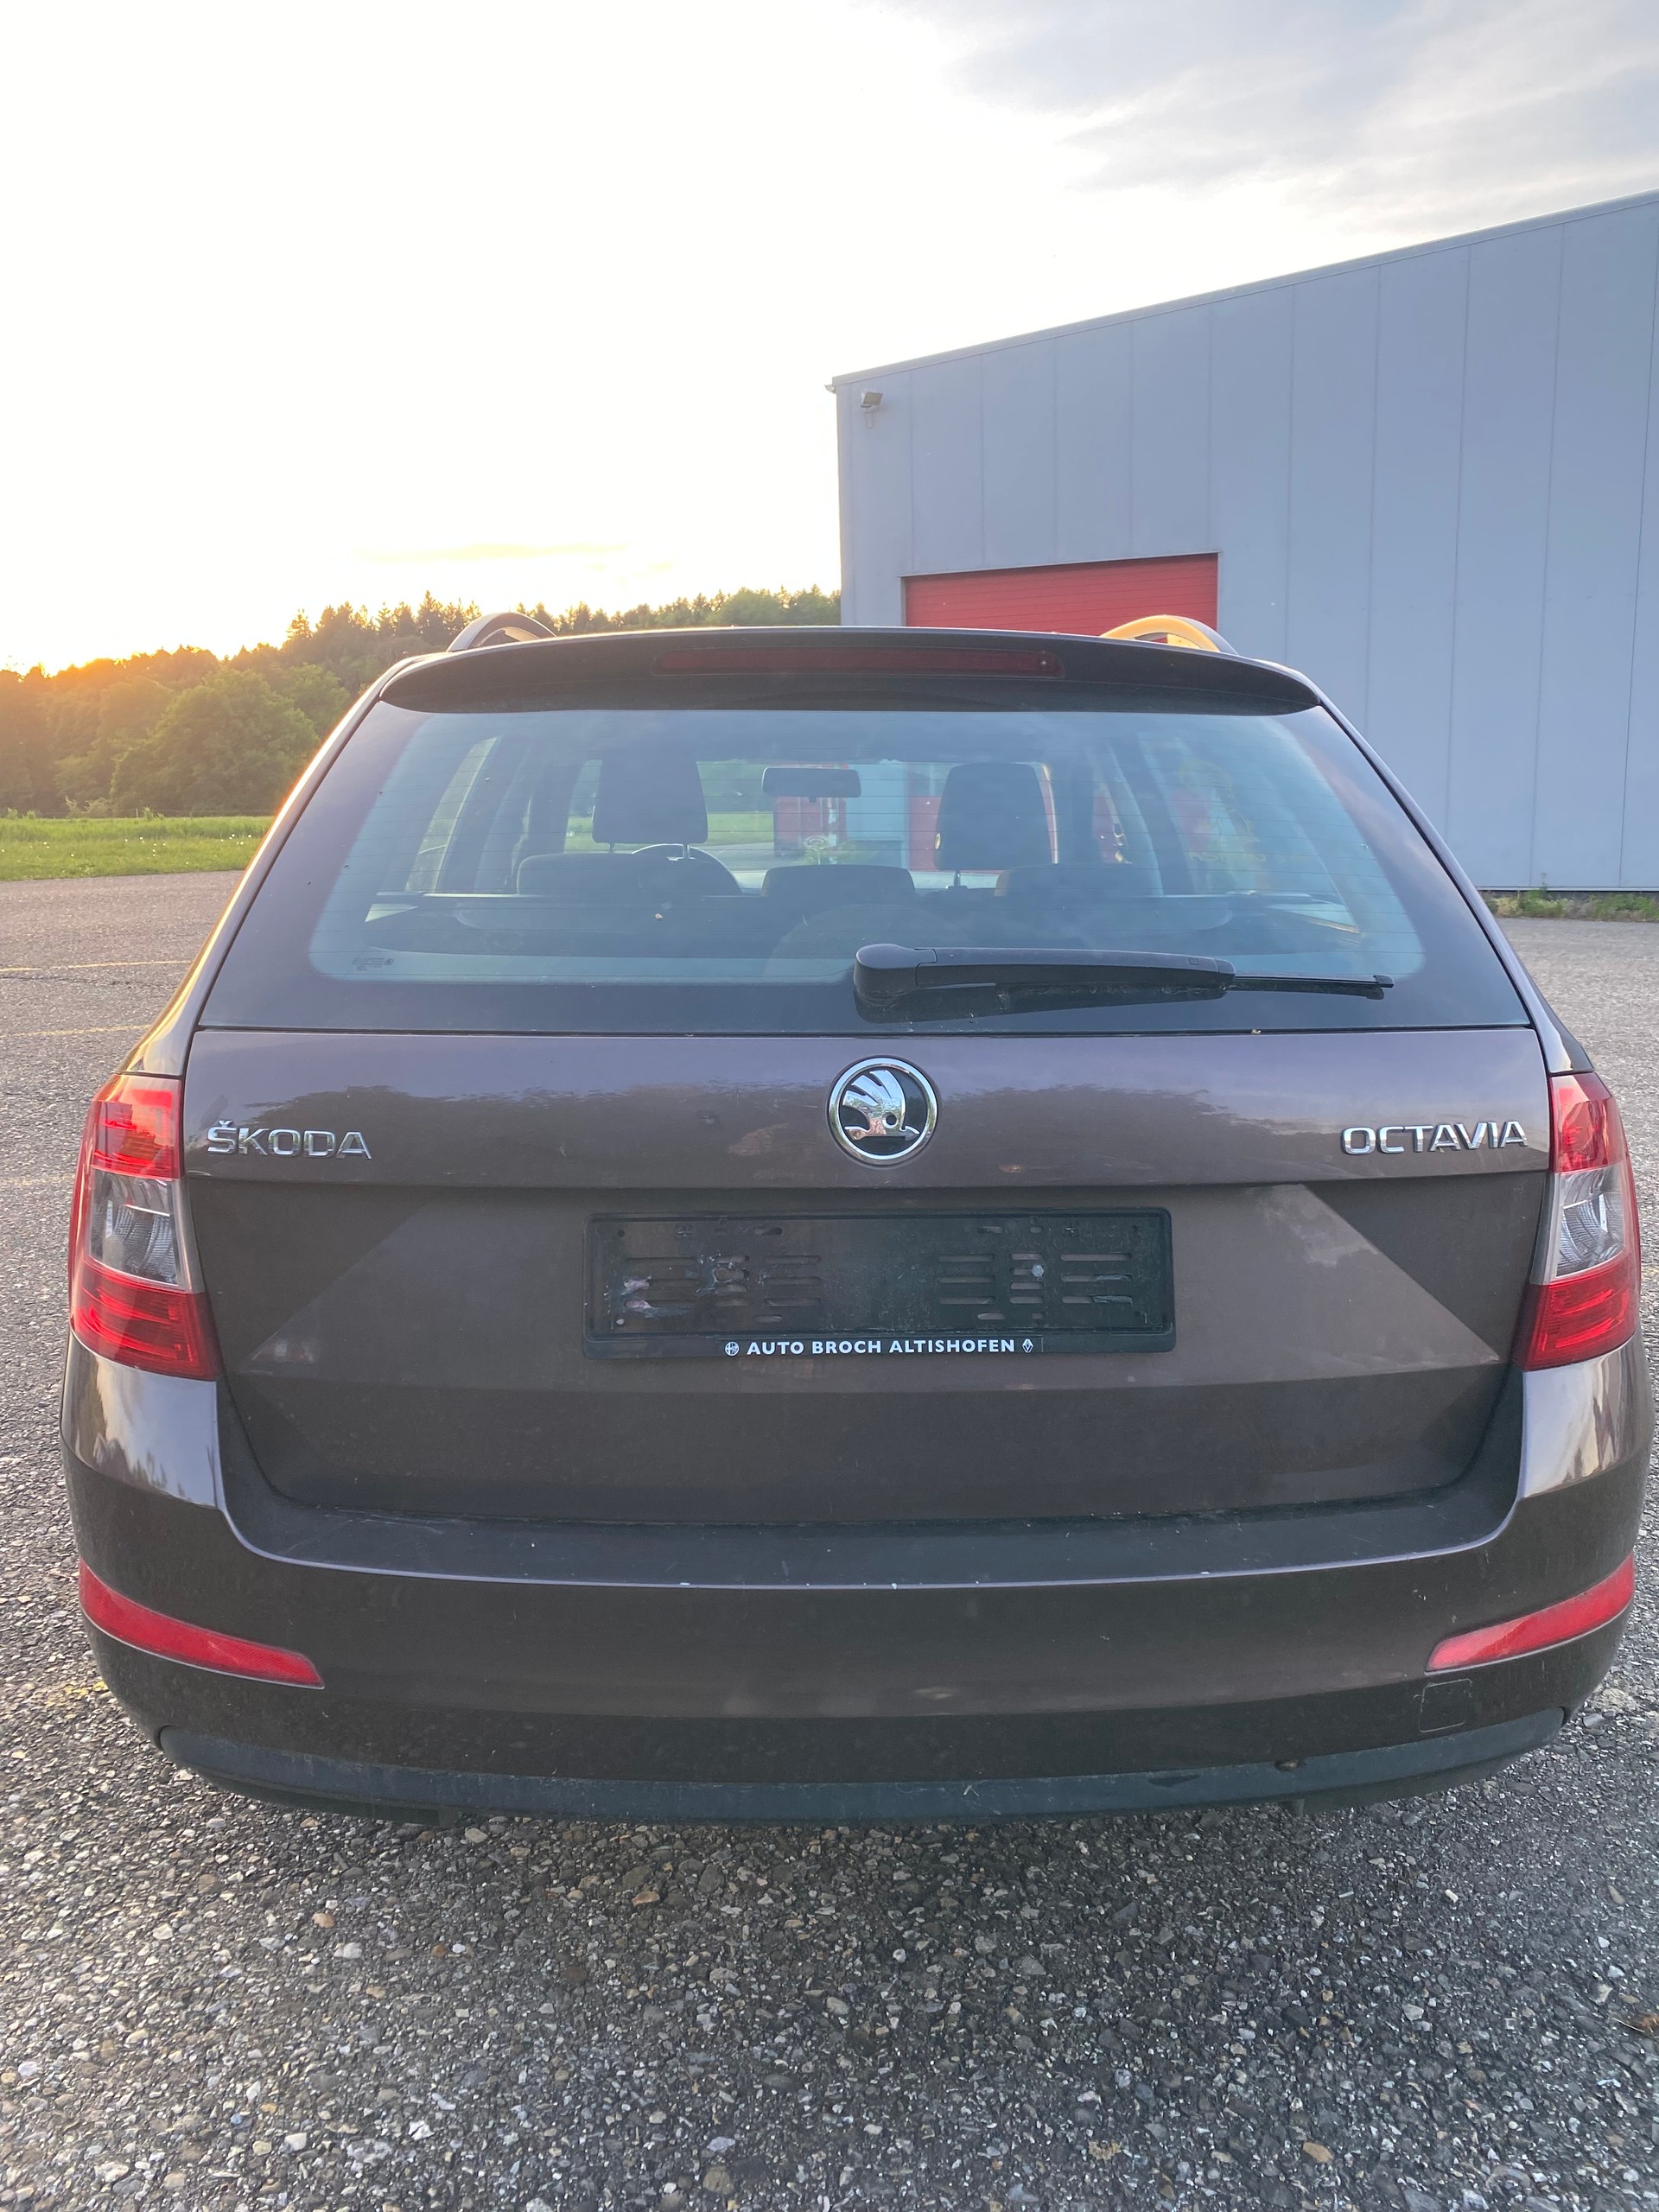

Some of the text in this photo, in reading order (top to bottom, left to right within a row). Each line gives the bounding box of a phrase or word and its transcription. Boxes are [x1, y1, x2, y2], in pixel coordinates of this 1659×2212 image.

[207, 1120, 372, 1160] ŠKODA
[1343, 1121, 1529, 1155] OCTAVIA
[747, 1338, 1014, 1356] AUTO BROCH ALTISHOFEN
